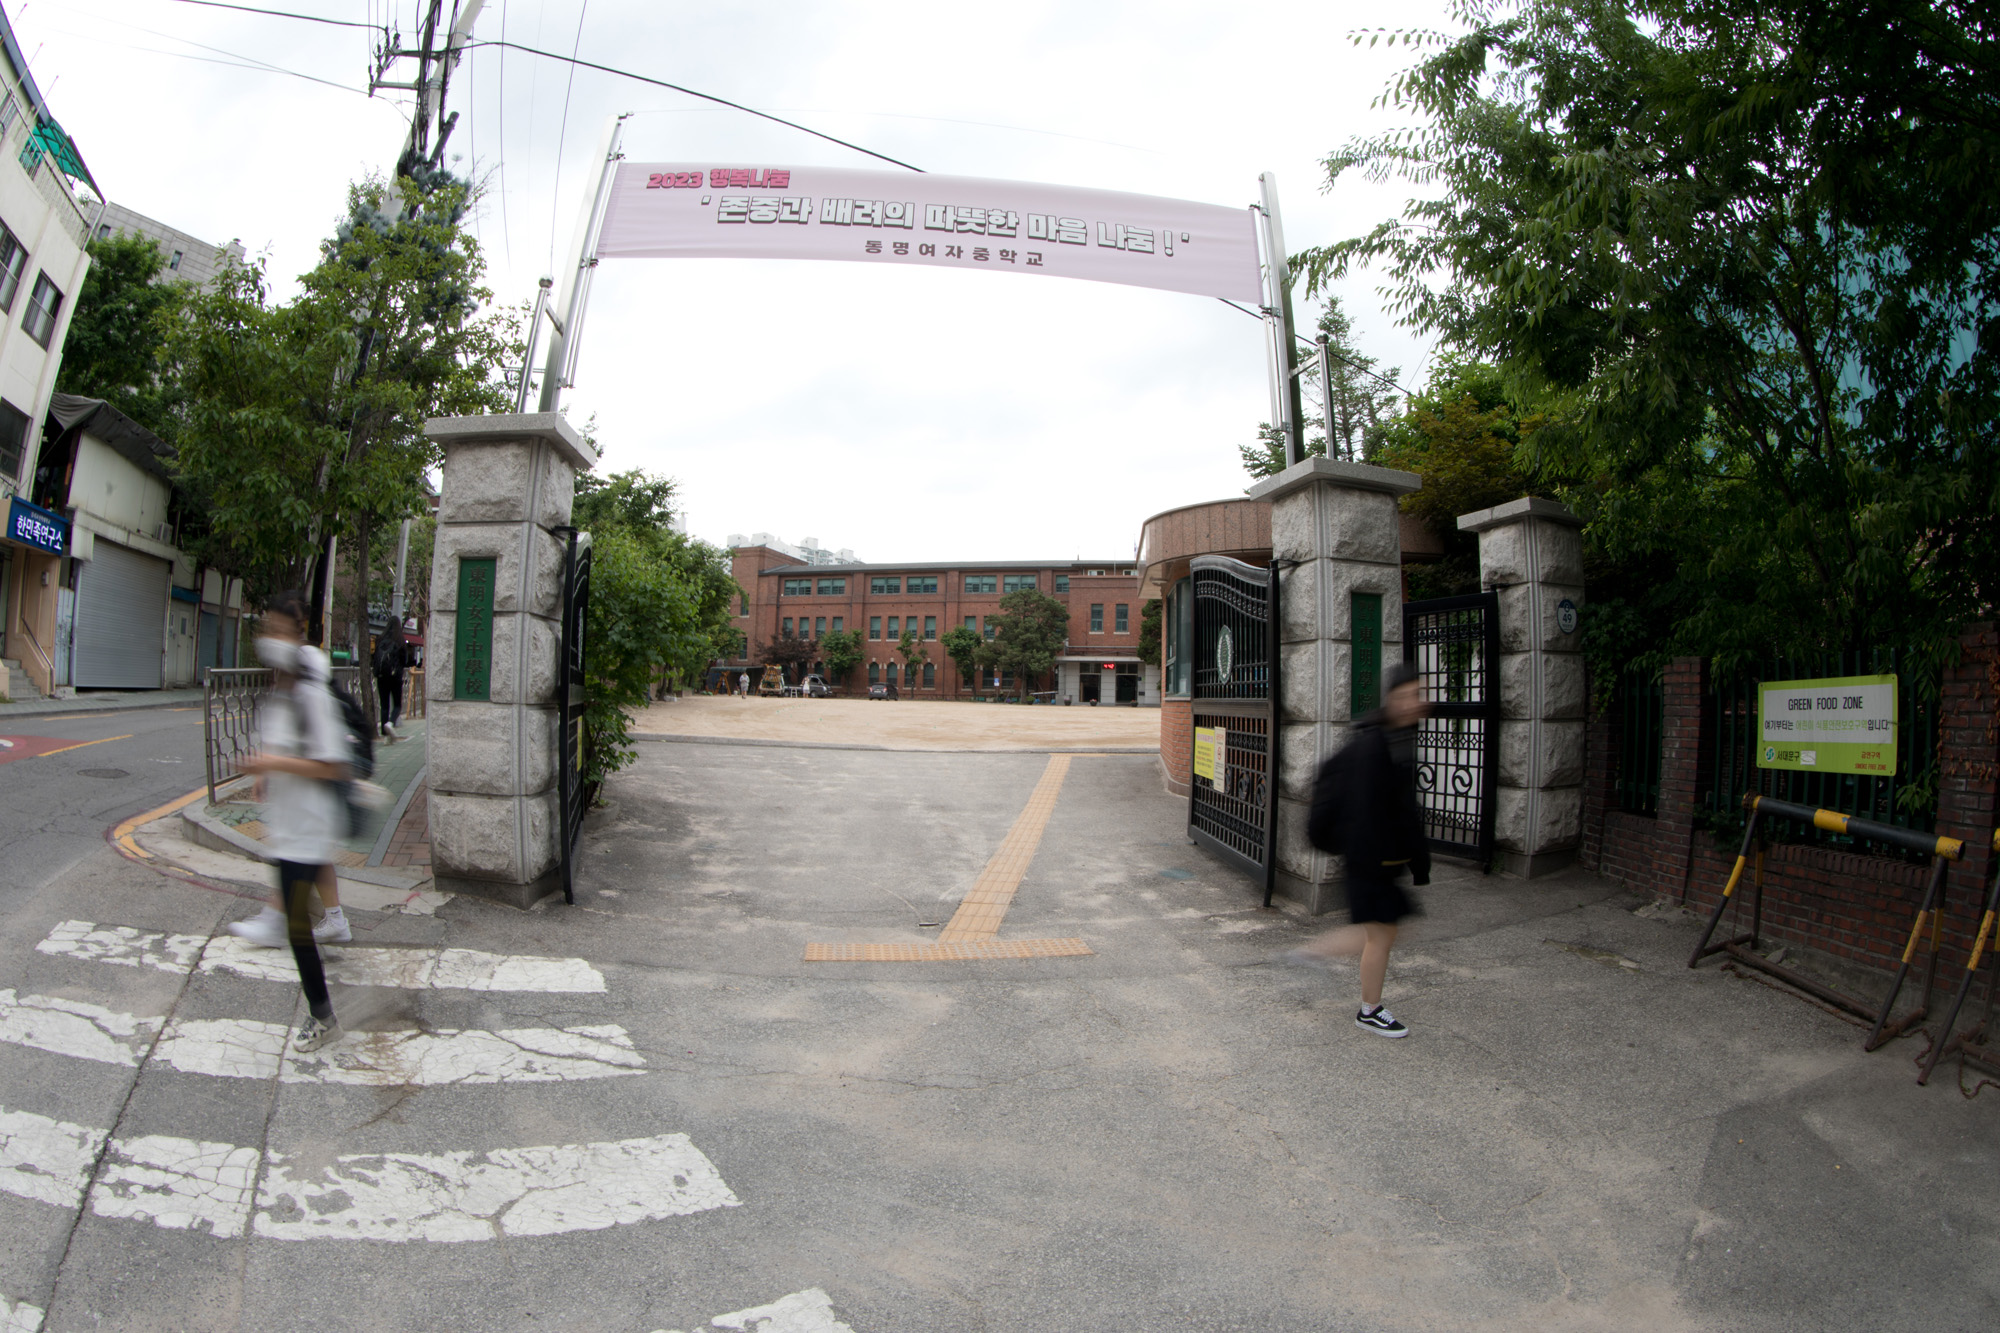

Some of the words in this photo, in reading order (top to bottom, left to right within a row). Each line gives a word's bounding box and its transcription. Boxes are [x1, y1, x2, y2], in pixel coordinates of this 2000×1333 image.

[646, 171, 703, 189] 2023
[709, 168, 790, 189] 행복나눔
[820, 198, 915, 229] 배려의
[924, 203, 1020, 238] 따뜻한
[1027, 213, 1087, 246] 마음
[865, 240, 1043, 266] 동명여자중학교
[16, 514, 63, 550] 한민족연구소
[1562, 613, 1572, 623] 49
[465, 565, 488, 695] 東明女子中學校
[1788, 698, 1812, 711] GREEN
[1816, 697, 1838, 710] FOOD
[1842, 696, 1863, 709] ZONE
[1764, 720, 1794, 731] 여기부터는
[1795, 720, 1814, 731] 어린이
[1777, 750, 1800, 761] 서대문구
